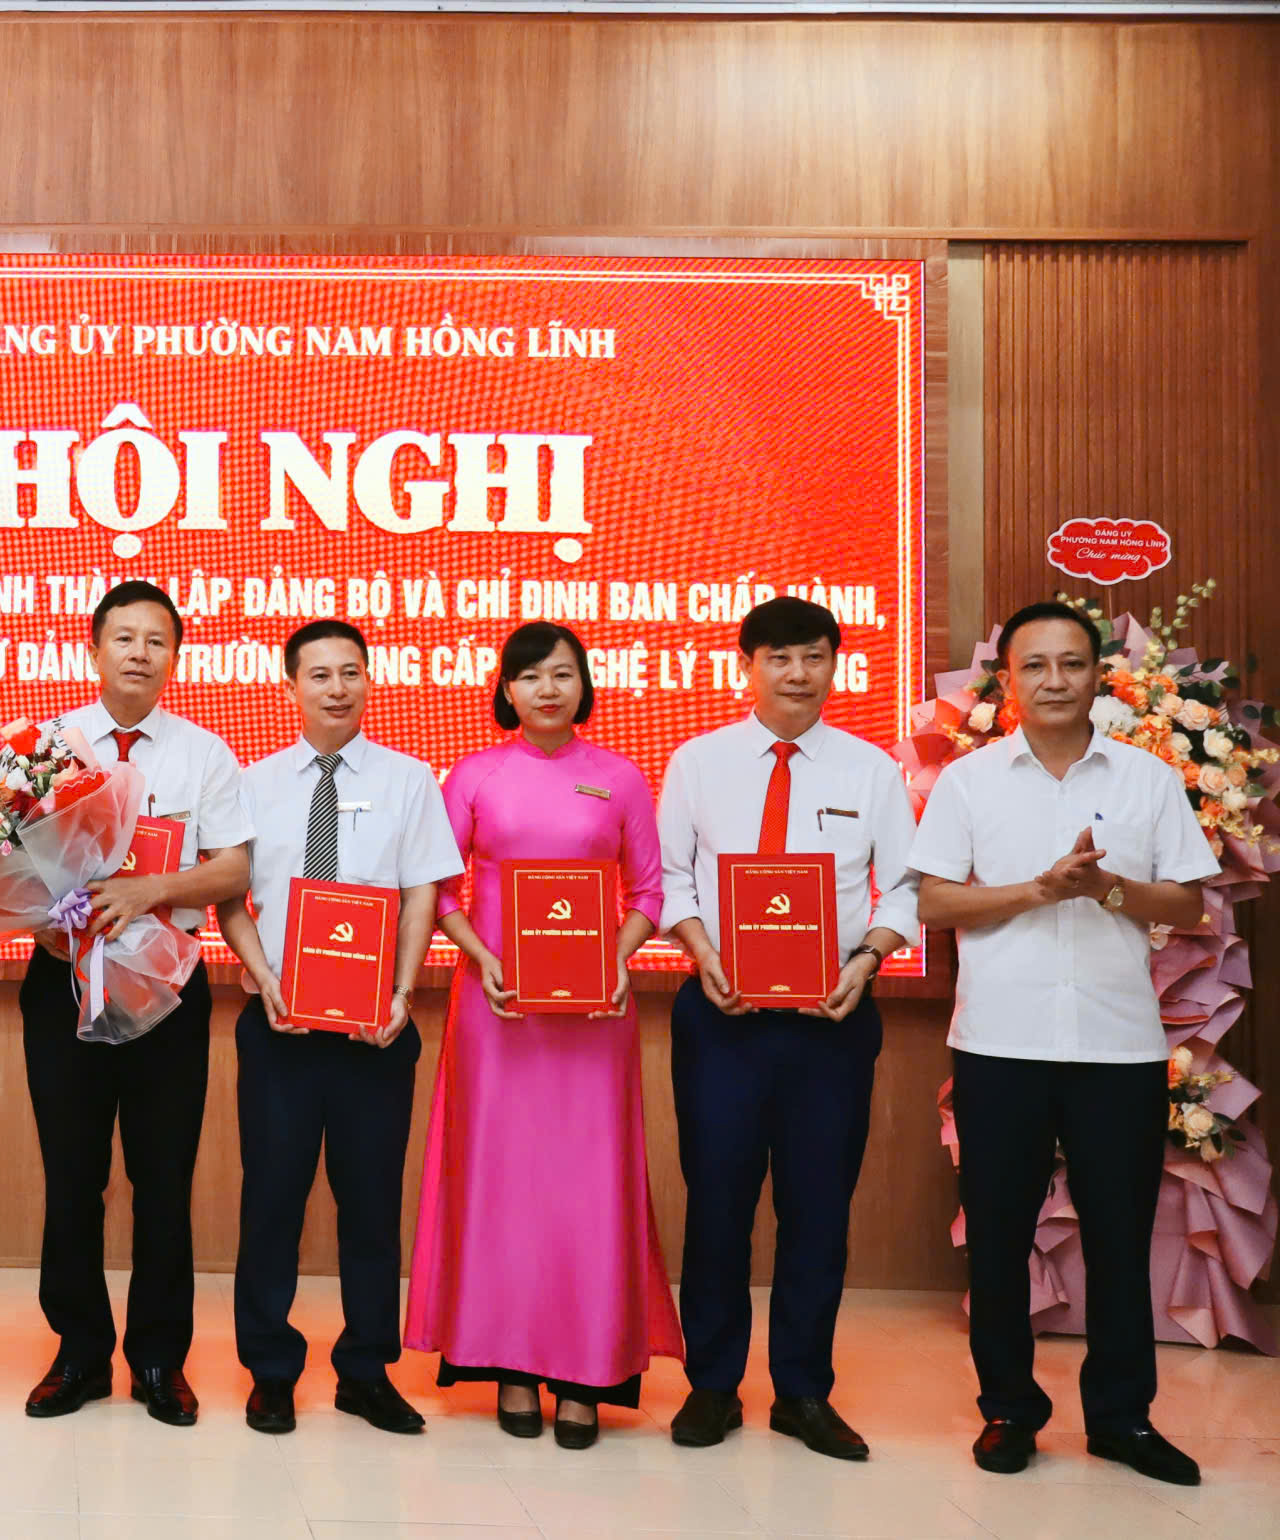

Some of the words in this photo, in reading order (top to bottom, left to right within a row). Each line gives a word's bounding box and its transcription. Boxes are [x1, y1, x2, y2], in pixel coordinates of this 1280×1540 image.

[69, 313, 121, 355] ỦY
[133, 317, 294, 356] PHƯỜNG
[305, 326, 393, 356] NAM
[406, 312, 516, 357] HỒNG
[528, 320, 616, 358] LĨNH
[260, 430, 593, 562] NGHỊ
[46, 567, 156, 615] THÀ
[169, 570, 231, 624] LẬP
[244, 565, 336, 617] ĐẢNG
[347, 571, 392, 626] BỘ
[403, 571, 446, 618] VÀ
[456, 567, 511, 619] CHỈ
[610, 582, 677, 622] BAN
[177, 635, 289, 684] TRƯỜN
[431, 635, 497, 686] CẤP
[586, 640, 649, 697] GHỆ
[659, 642, 698, 690] LÝ
